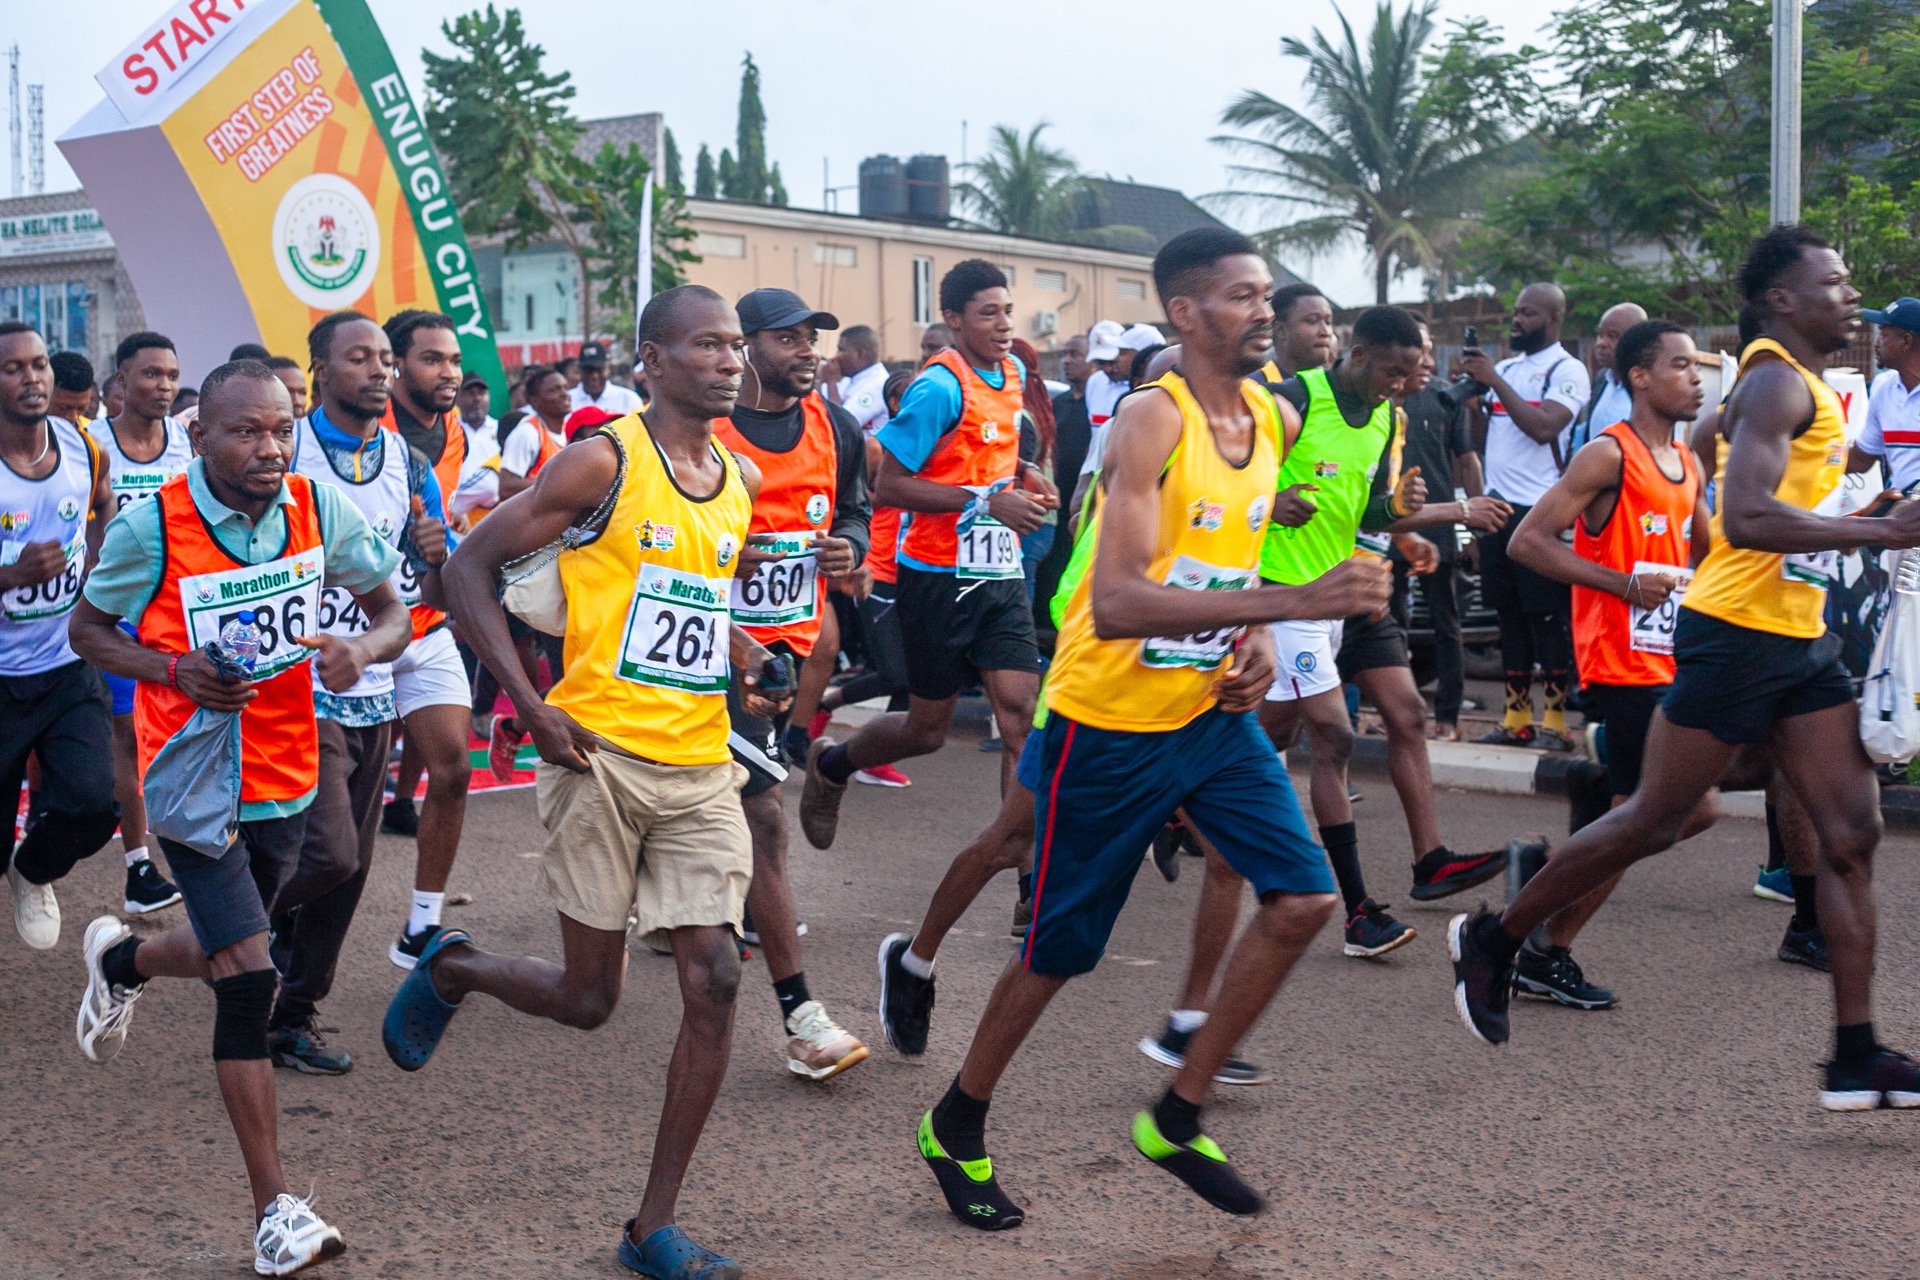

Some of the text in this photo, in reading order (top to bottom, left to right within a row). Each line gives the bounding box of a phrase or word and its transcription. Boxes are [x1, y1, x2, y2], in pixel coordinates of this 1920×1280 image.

[204, 45, 322, 163] FIRST STEP OF
[236, 85, 334, 182] GREATNESS
[371, 72, 488, 339] ENUGU CITY
[121, 473, 164, 485] Marathon
[963, 529, 1014, 564] 1199
[219, 570, 290, 599] Marathon
[741, 562, 804, 607] 660
[319, 588, 371, 632] 64
[646, 610, 716, 670] 264
